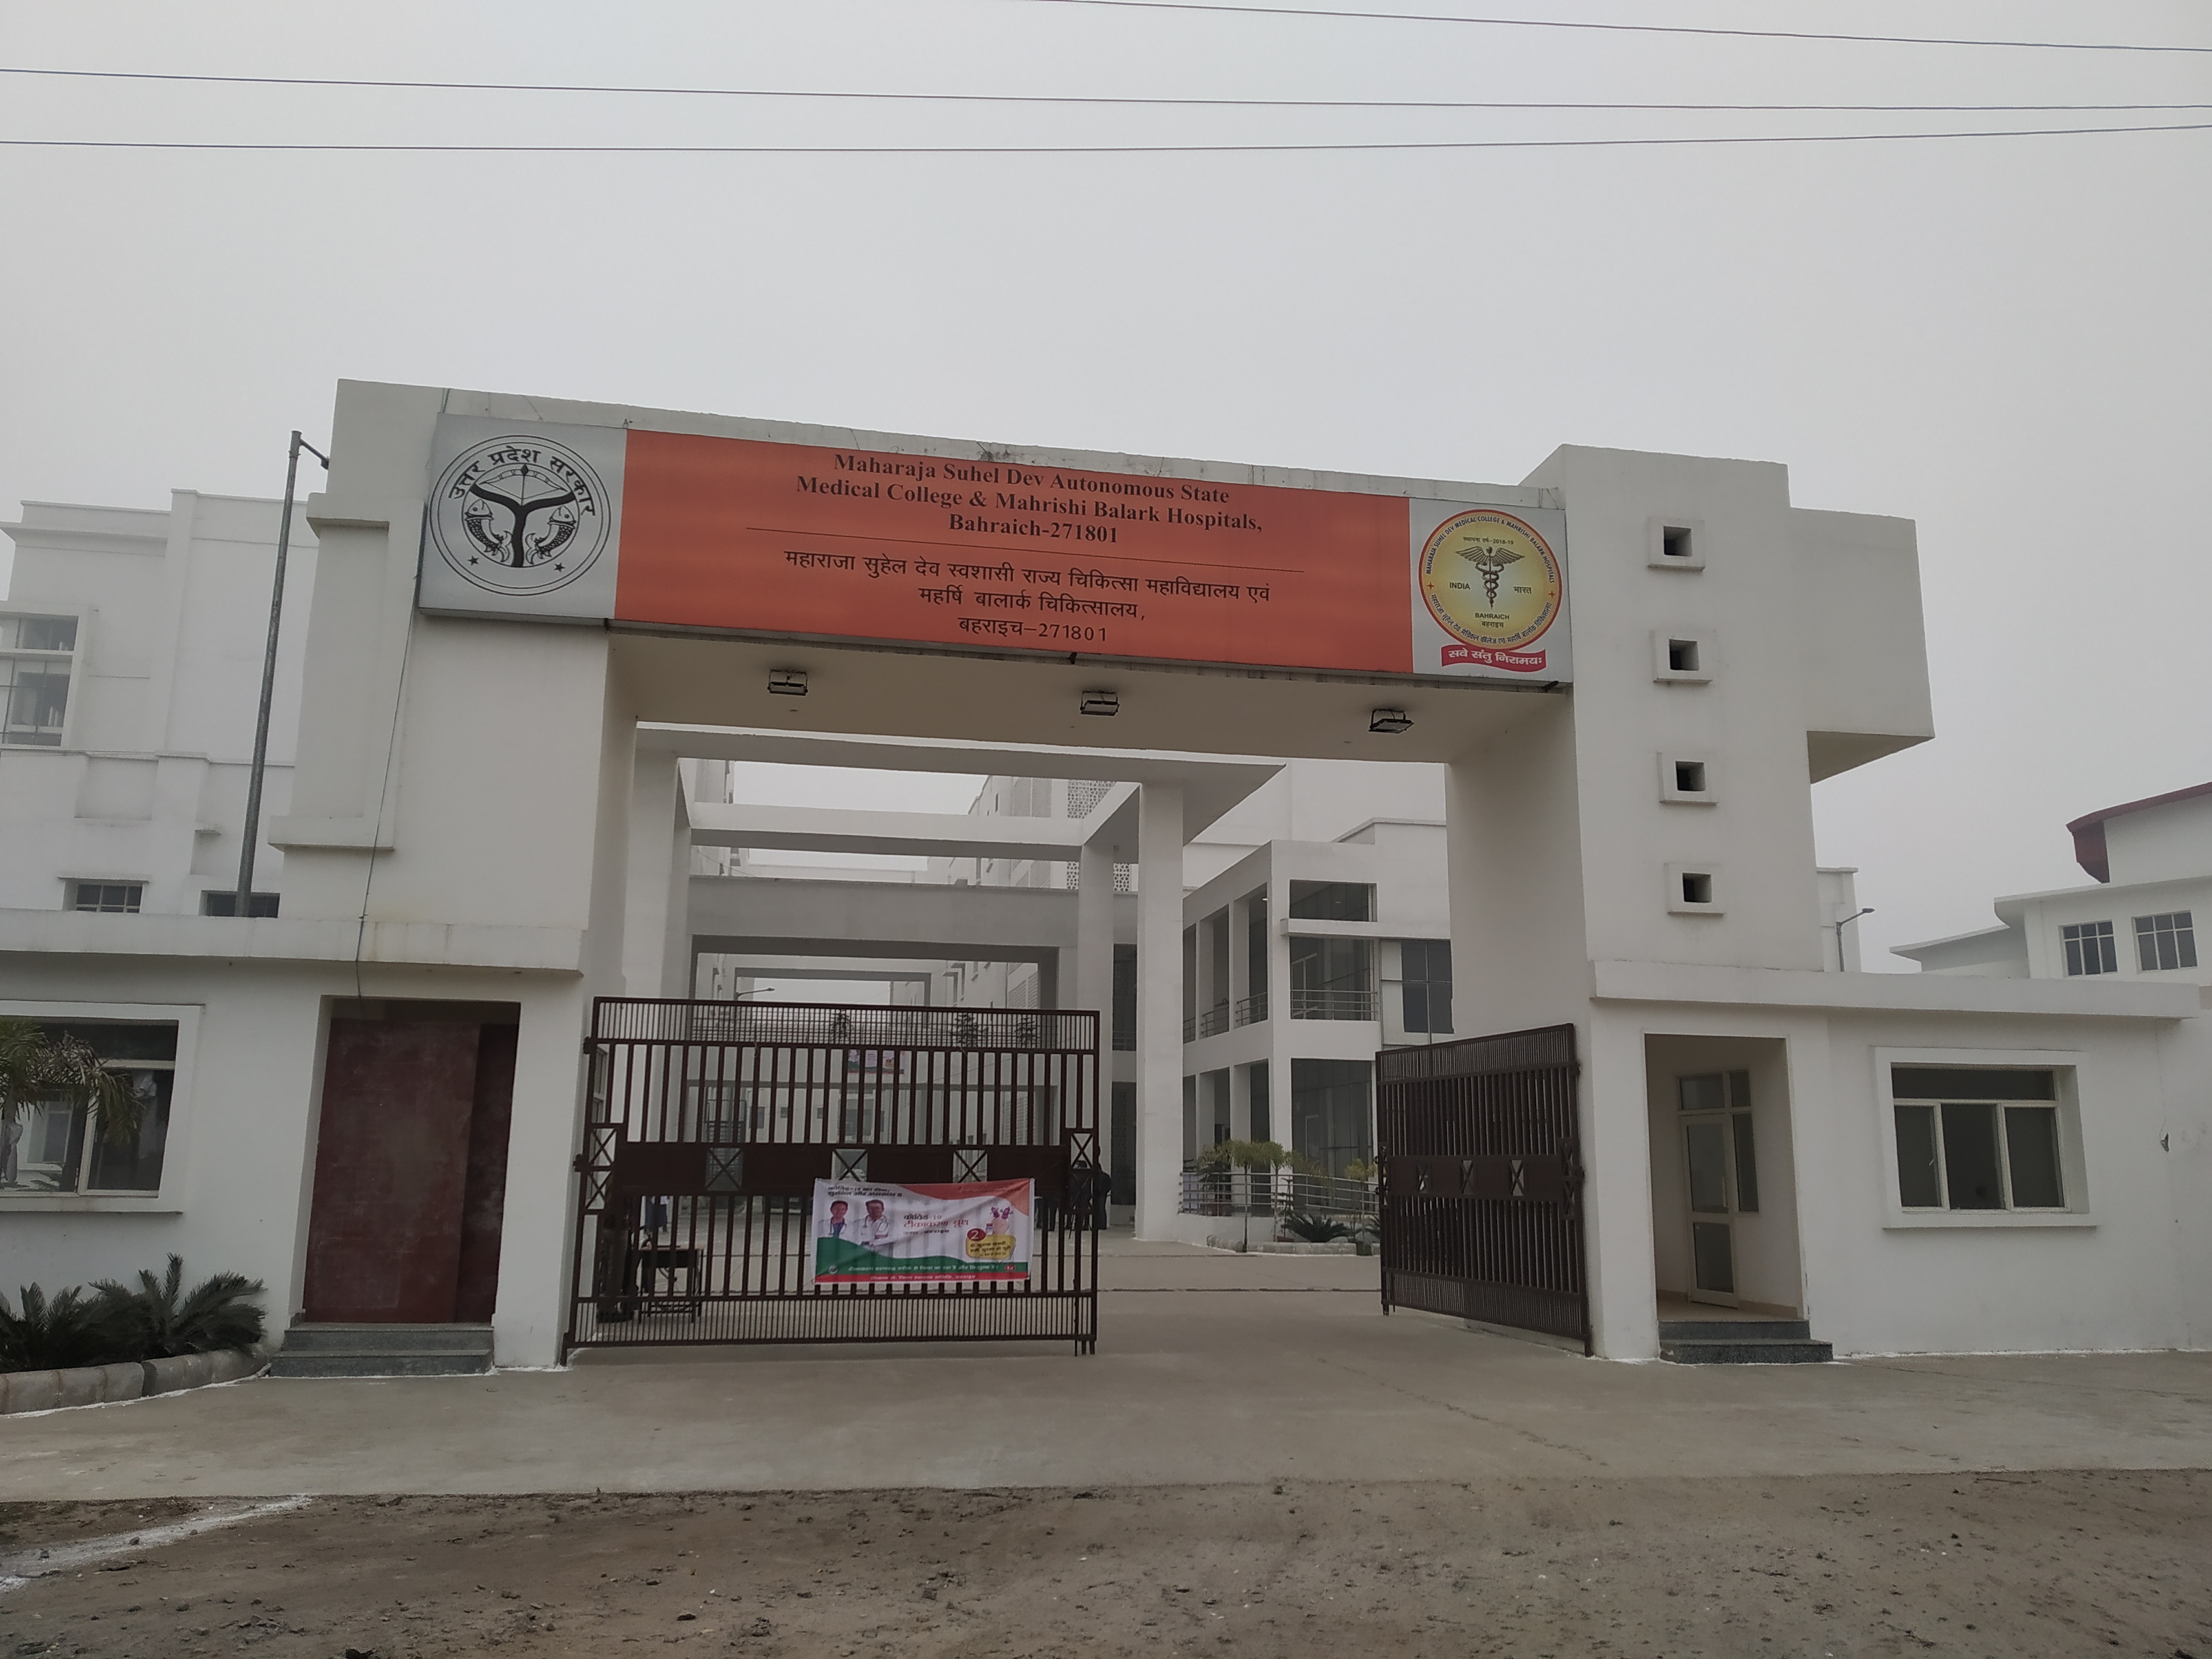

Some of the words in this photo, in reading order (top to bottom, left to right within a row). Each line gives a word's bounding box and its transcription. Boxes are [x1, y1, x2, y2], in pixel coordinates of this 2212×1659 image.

[488, 446, 541, 465] प्रदेश
[550, 456, 596, 516] सरकार
[834, 454, 936, 481] Maharaja
[943, 463, 999, 483] Suhel
[1006, 469, 1044, 488] Dev
[1051, 473, 1174, 499] Autonomous
[1181, 484, 1229, 503] State
[797, 476, 879, 498] Medical
[888, 483, 962, 509] College
[969, 491, 987, 507] &
[995, 493, 1086, 516] Mahrishi
[1094, 500, 1160, 522] Balark
[1167, 508, 1262, 533] Hospitals,
[950, 514, 1117, 543] Bahraich-271801
[1426, 547, 1437, 575] MAHARAJA
[1433, 533, 1447, 547] SUHEL
[1444, 525, 1454, 535] DEV
[1454, 517, 1477, 528] MEDICAL
[1506, 521, 1531, 539] MAHRISHI
[1530, 537, 1545, 556] BALARK
[1543, 556, 1555, 583] HOSPITALS
[784, 551, 855, 570] महाराजा
[863, 553, 907, 578] सुहेल
[914, 556, 940, 576] देव
[947, 561, 1014, 582] स्वशासी
[1021, 568, 1061, 586] राज्य
[1068, 567, 1139, 592] चिकित्सा
[1145, 576, 1240, 599] महाविद्यालय
[1246, 583, 1270, 603] एवं
[1514, 586, 1531, 594] भारत
[918, 585, 963, 605] महर्षि
[974, 590, 1031, 609] बालार्क
[1038, 591, 1146, 620] चिकित्सालय,
[1431, 594, 1444, 614] महाराजा
[1441, 613, 1454, 626] सुहेल
[1470, 649, 1492, 664] संतु
[971, 1230, 979, 1239] 2
